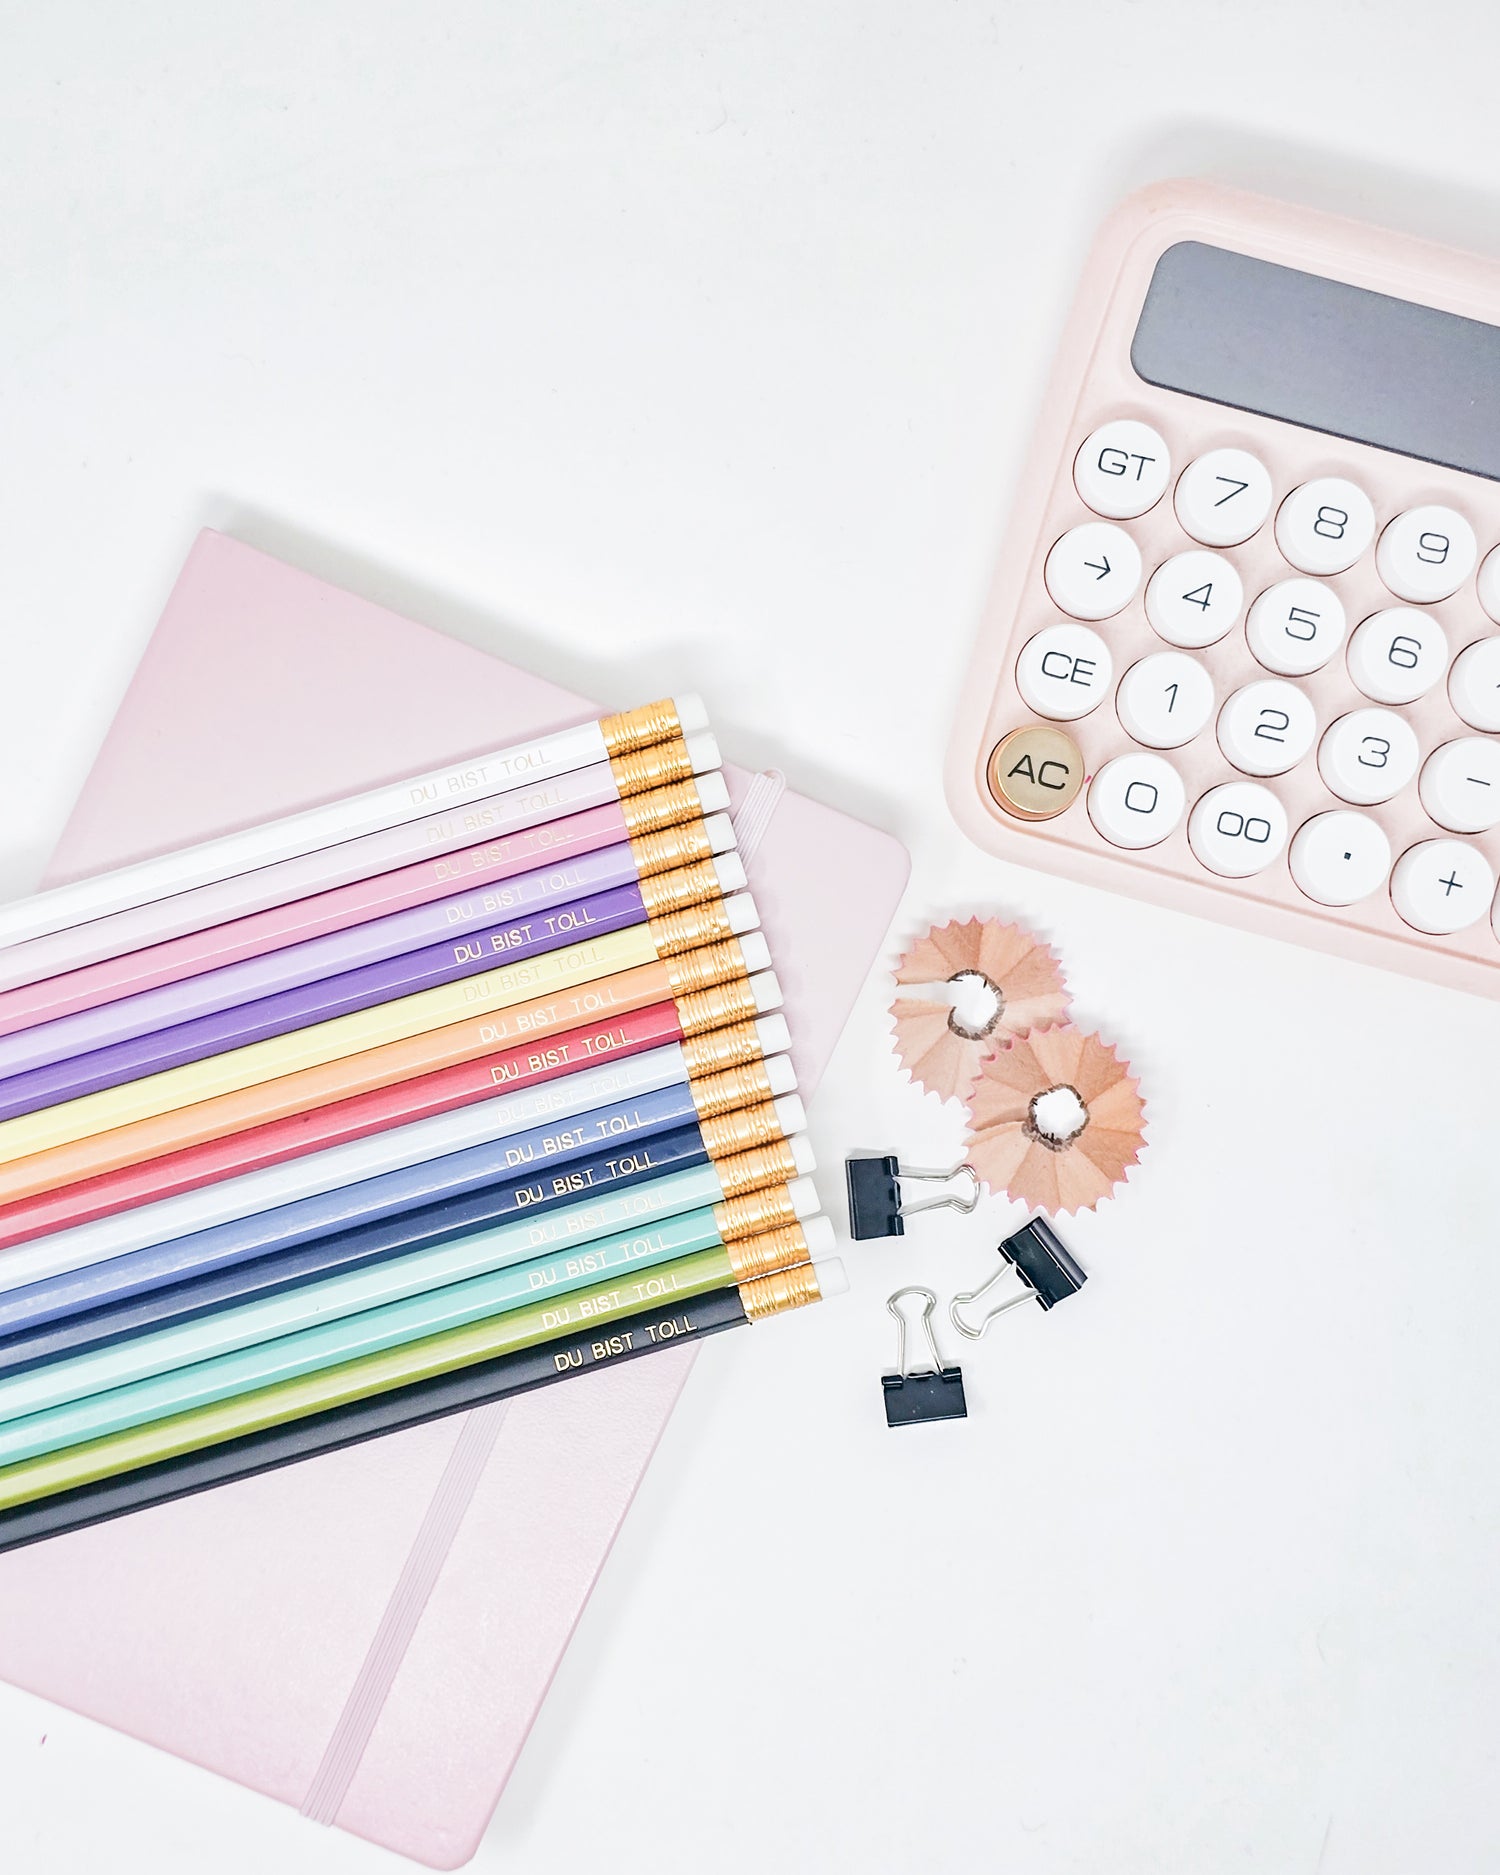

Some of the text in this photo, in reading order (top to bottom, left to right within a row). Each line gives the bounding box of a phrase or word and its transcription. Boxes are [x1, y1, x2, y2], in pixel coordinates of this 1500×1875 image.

[1097, 447, 1155, 481] GT
[1214, 477, 1249, 507] 7
[1314, 505, 1348, 539] 8
[1417, 533, 1449, 564] 9
[1182, 582, 1214, 612] 4
[1285, 606, 1320, 641] 5
[1041, 651, 1096, 687] CE
[1389, 636, 1421, 668] 6
[1164, 683, 1179, 712] 1
[1254, 709, 1289, 742] 2
[1358, 736, 1390, 768] 3
[410, 749, 551, 805] DU BIST TOLL
[1008, 753, 1069, 790] AC
[1125, 781, 1158, 813] 0
[426, 789, 568, 844] DU BIST TOLL
[433, 825, 575, 880] DU BIST TOLL
[446, 869, 587, 924] DU BIST TOLL
[453, 908, 596, 963] DU BIST TOLL
[463, 947, 604, 1002] DU BIST TOLL
[480, 990, 620, 1043] DU BIST TOLL
[491, 1029, 633, 1084] DU BIST TOLL
[496, 1073, 635, 1126] DU BIST TOLL
[505, 1111, 648, 1168] DU BIST TOLL
[515, 1152, 657, 1207] DU BIST TOLL
[529, 1192, 671, 1246] DU BIST TOLL
[529, 1234, 671, 1290] DU BIST TOLL
[542, 1274, 685, 1330] DU BIST TOLL
[554, 1316, 697, 1372] DU BIST TOLL
